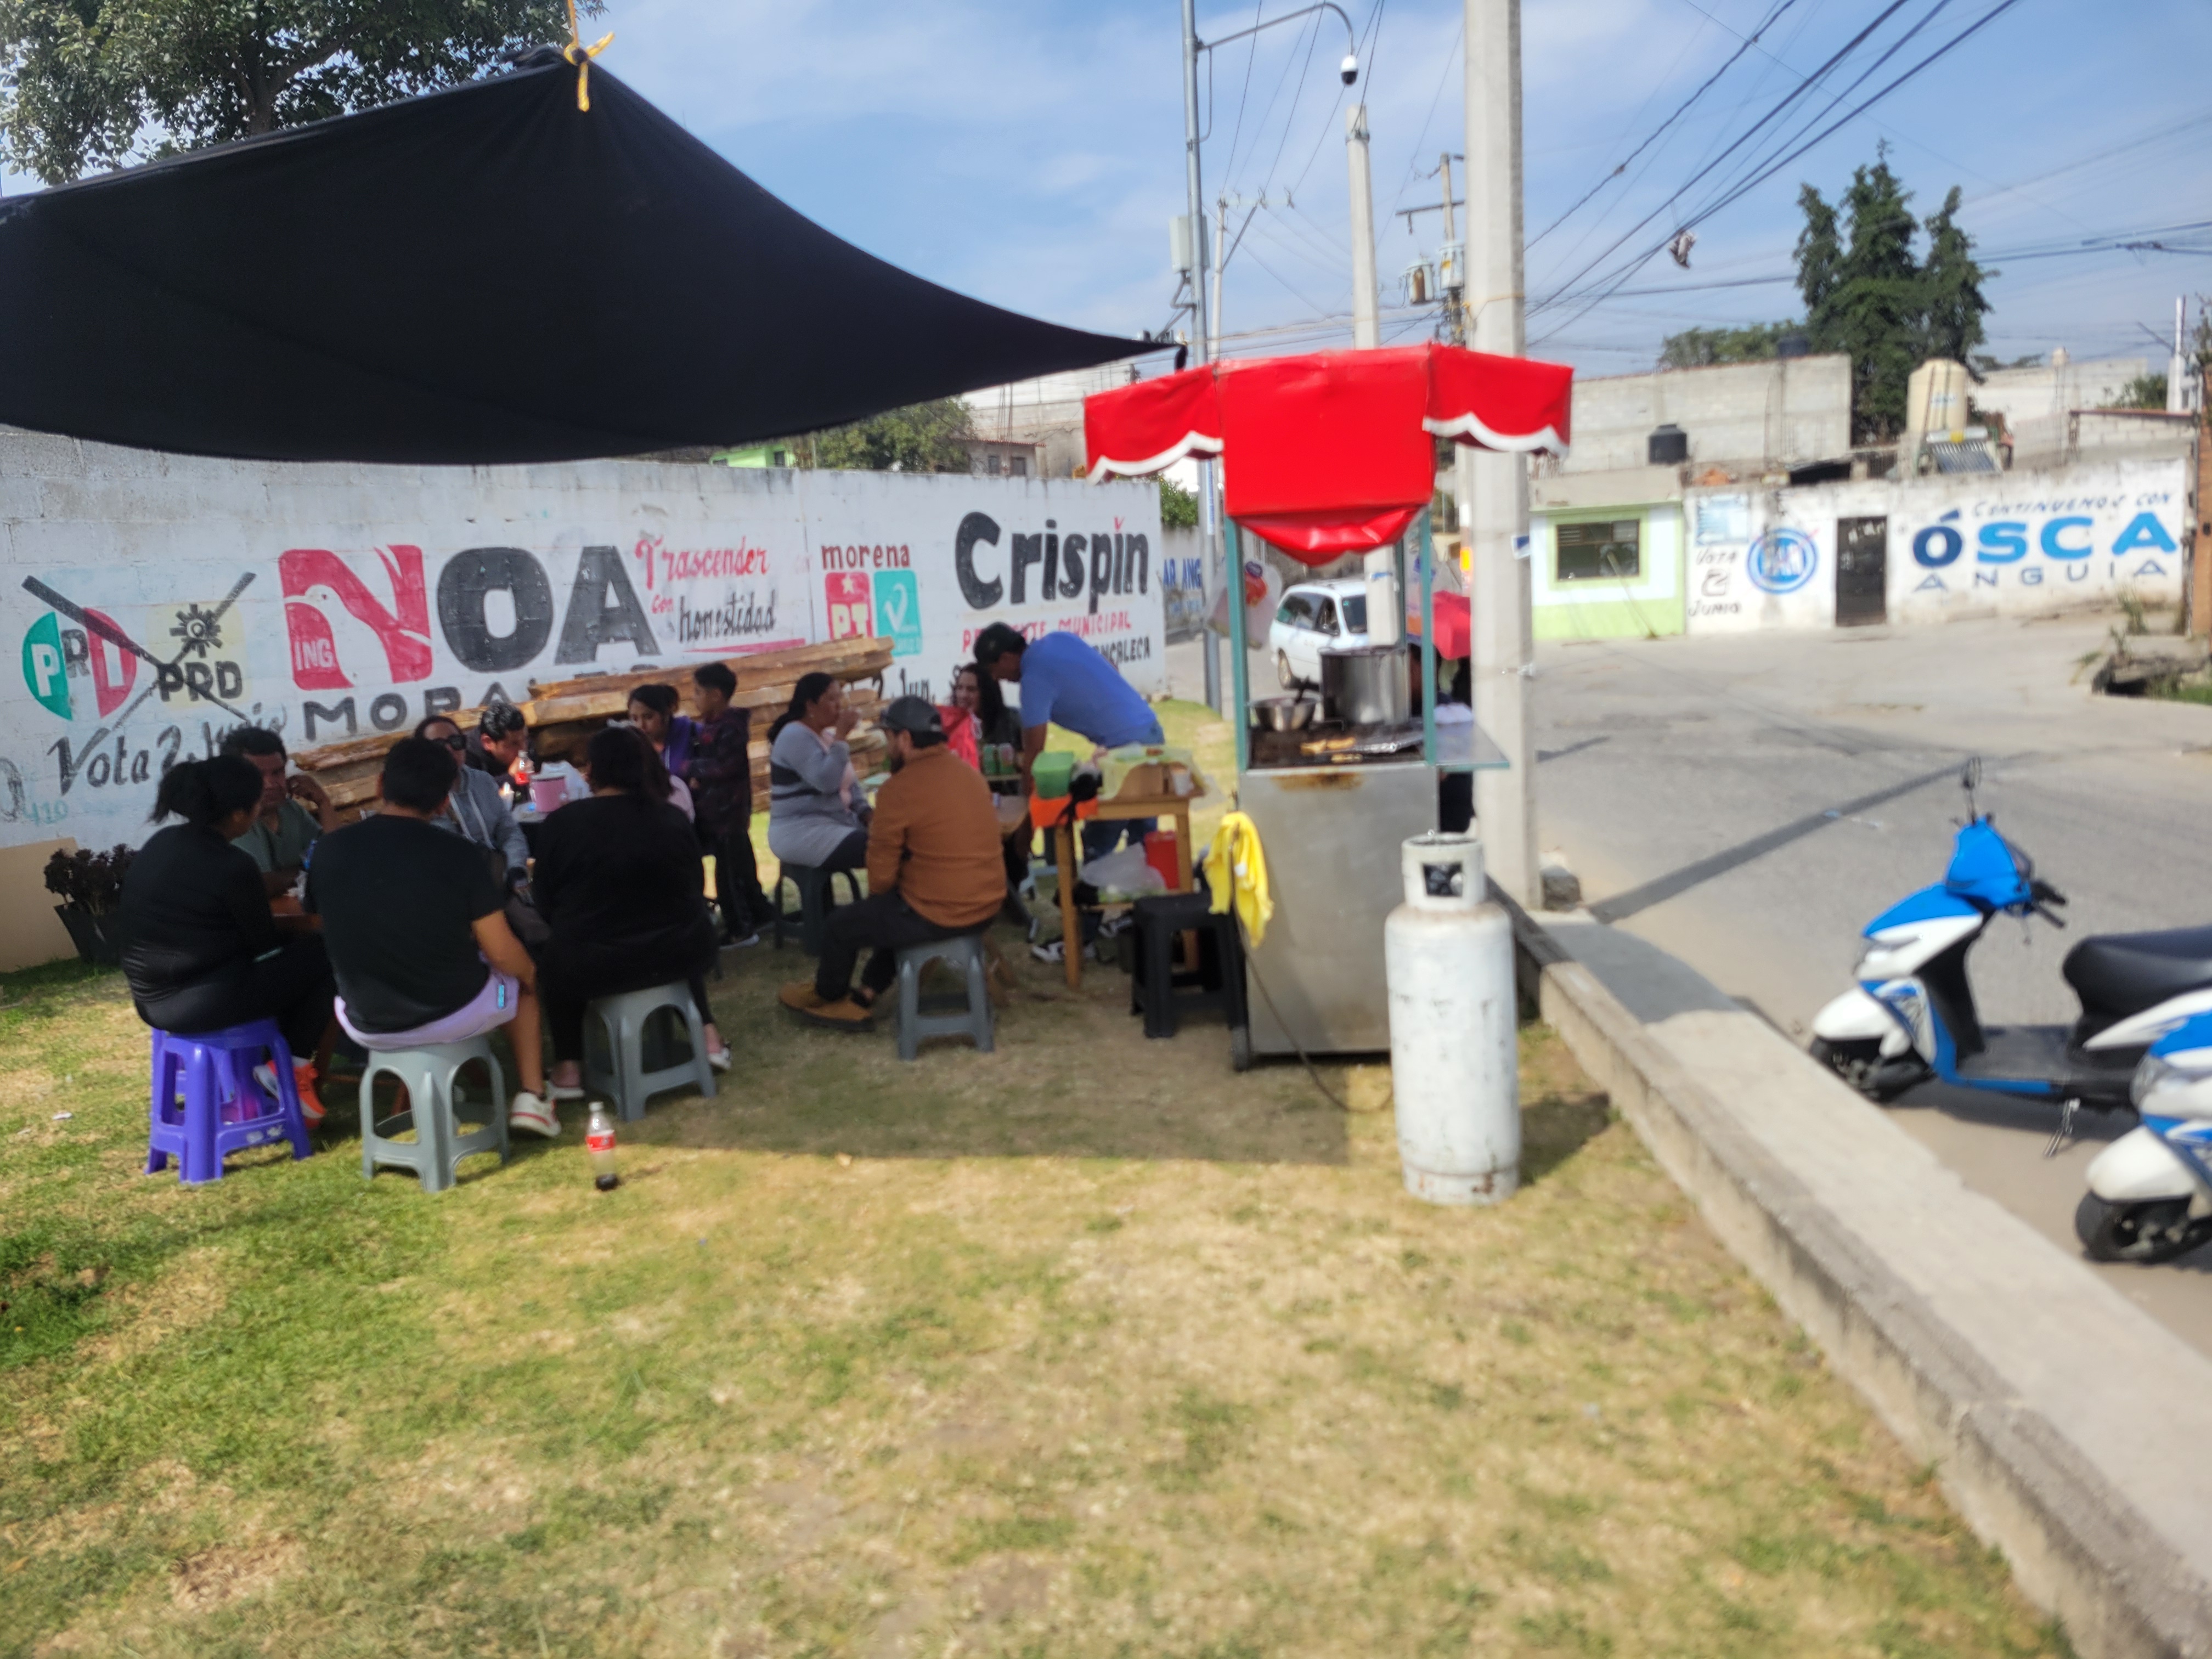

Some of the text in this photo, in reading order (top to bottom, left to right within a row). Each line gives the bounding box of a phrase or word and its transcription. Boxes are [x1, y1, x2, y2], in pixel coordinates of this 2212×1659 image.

[634, 534, 771, 590] Trascender
[821, 544, 910, 569] morena
[1912, 560, 2167, 593] ANGUIA
[278, 545, 663, 690] NOA
[679, 589, 776, 643] honestidad
[831, 603, 868, 639] PT
[1058, 610, 1132, 637] MUNICIPAL
[294, 638, 333, 671] ING
[157, 660, 244, 702] PRD
[47, 728, 149, 797] Vota
